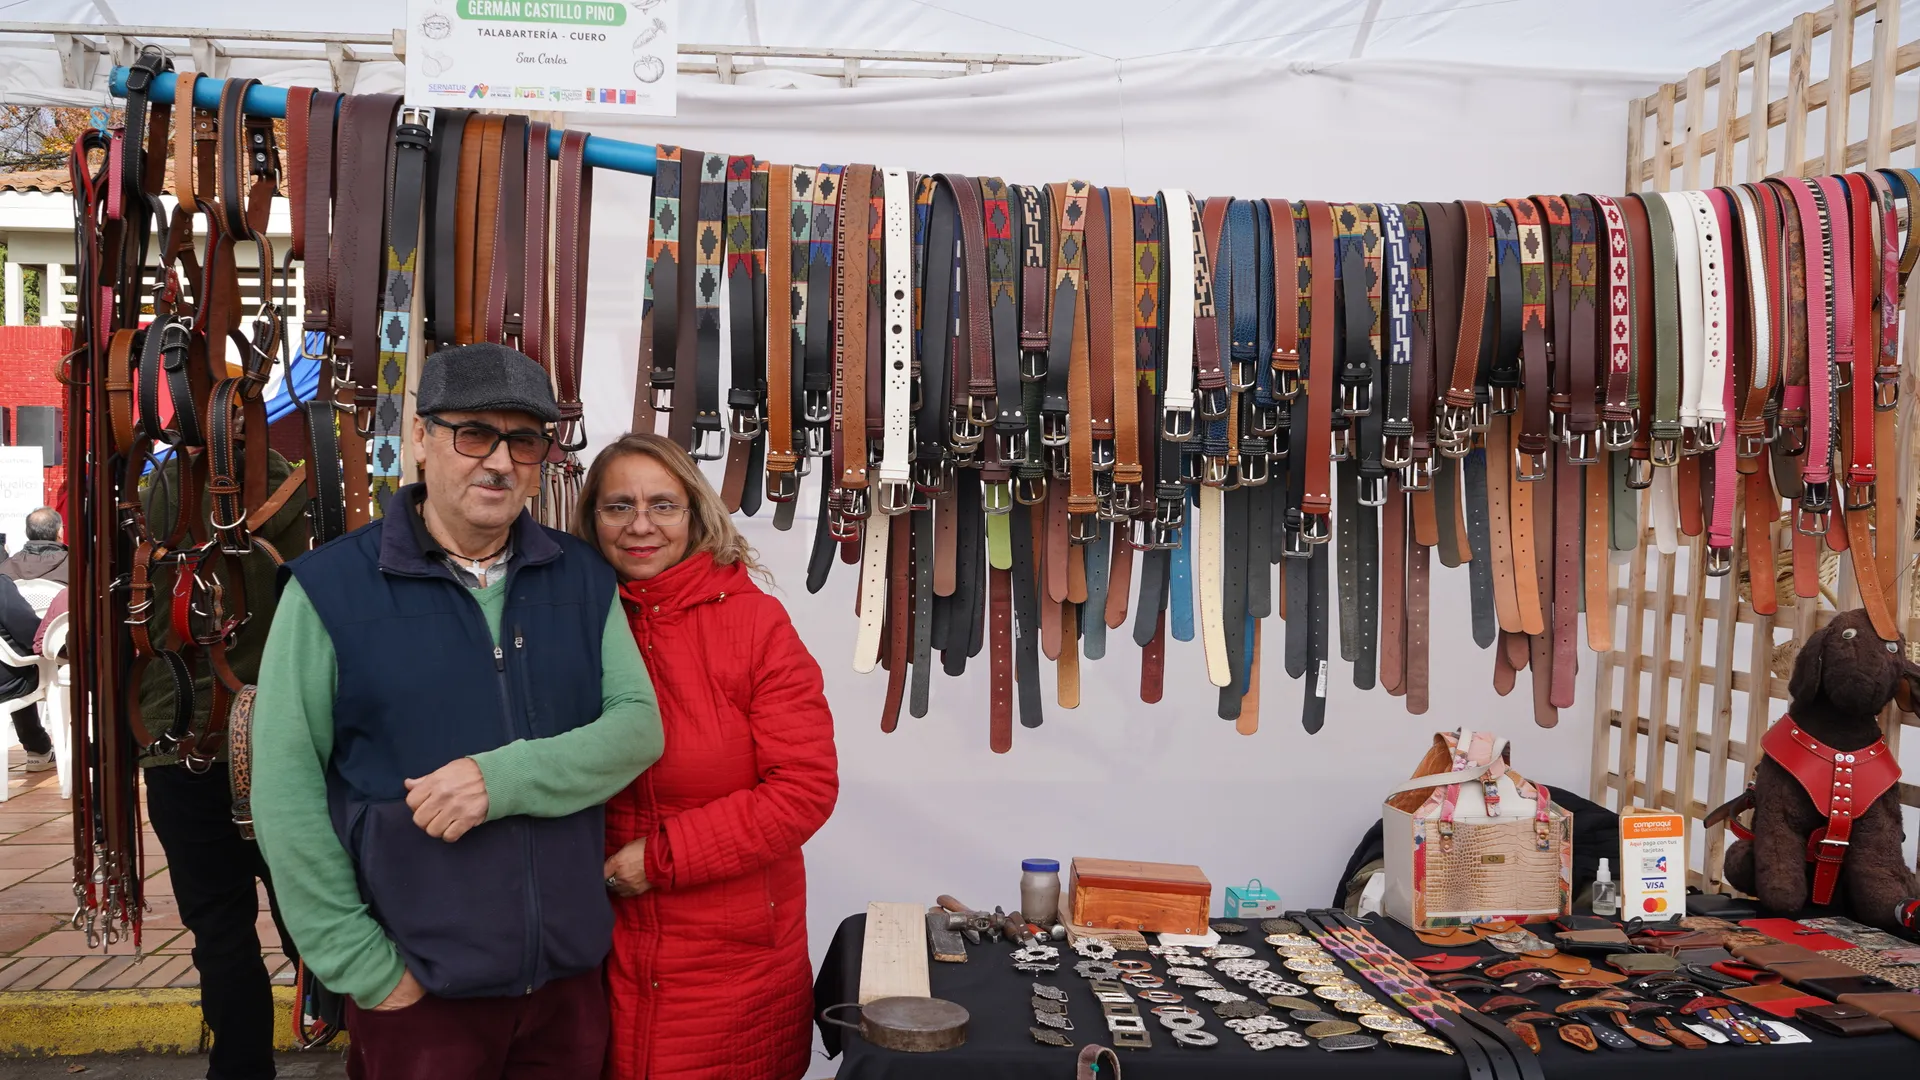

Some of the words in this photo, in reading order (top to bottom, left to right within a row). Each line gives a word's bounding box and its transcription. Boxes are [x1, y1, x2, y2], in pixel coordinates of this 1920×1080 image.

[524, 2, 582, 20] CASTILLO
[585, 5, 615, 21] PINO
[478, 28, 558, 40] TALABARTERÍA
[570, 32, 606, 42] CUERO
[516, 52, 535, 64] San
[538, 52, 568, 65] Carlos
[428, 83, 467, 91] SERNATUR
[1645, 881, 1665, 889] VISA
